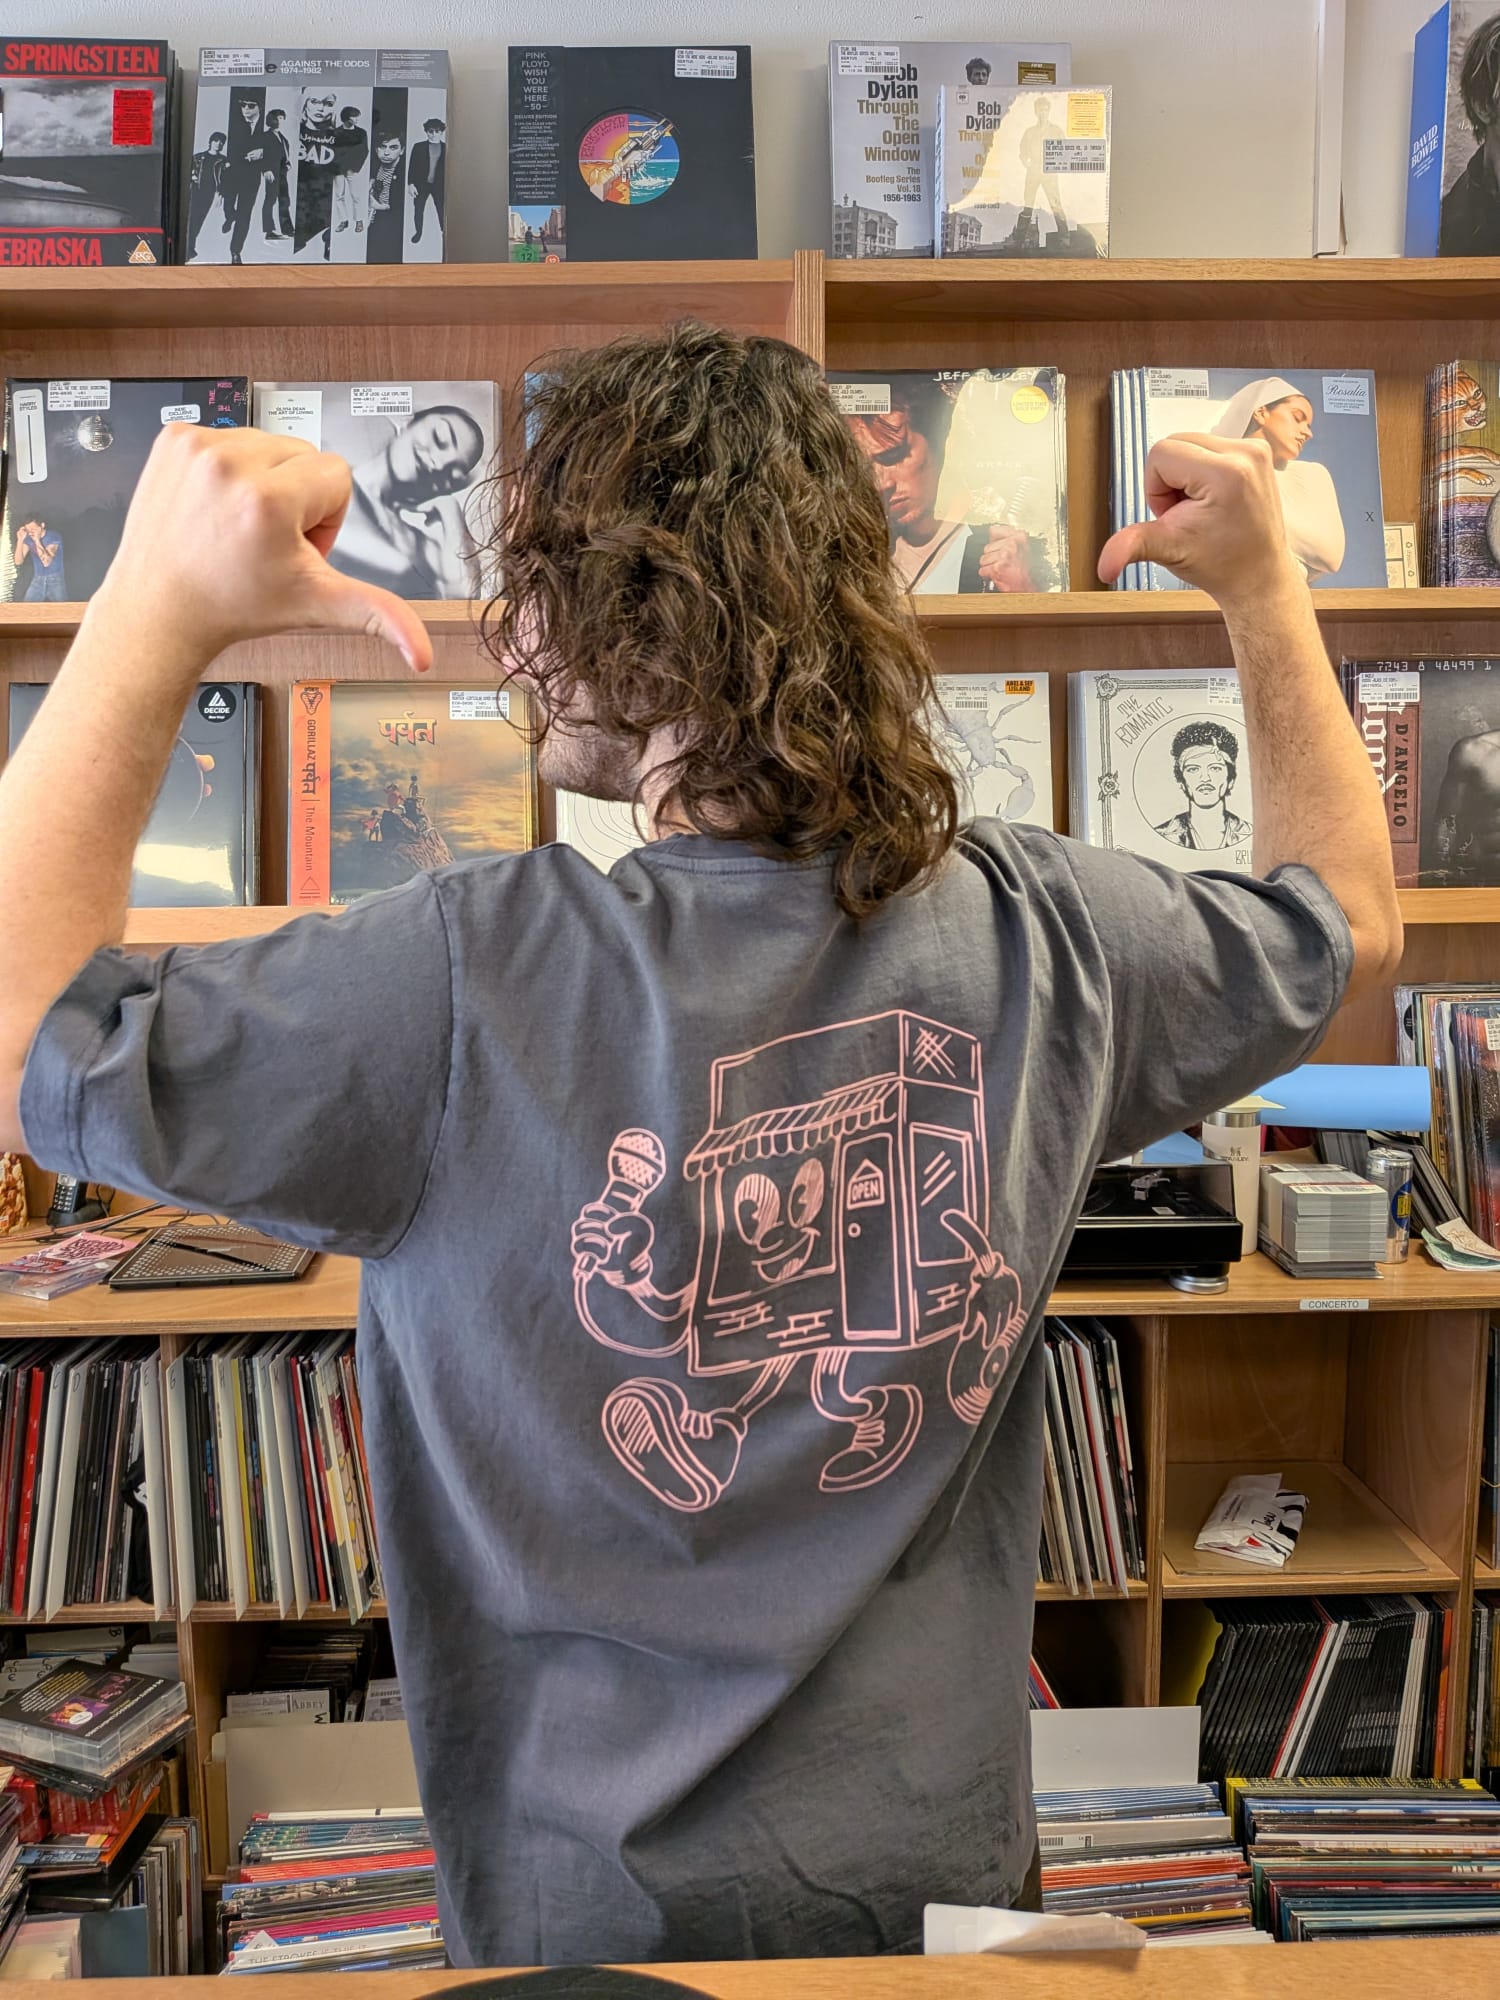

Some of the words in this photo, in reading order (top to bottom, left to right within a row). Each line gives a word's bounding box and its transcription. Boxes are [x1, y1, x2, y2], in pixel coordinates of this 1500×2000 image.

[4, 42, 160, 74] SPRINGSTEEN
[525, 52, 547, 60] PINK
[280, 60, 322, 68] AGAINST
[325, 60, 343, 68] THE
[344, 60, 370, 68] ODDS
[521, 60, 550, 68] FLOYD
[523, 68, 548, 76] WISH
[526, 77, 546, 85] YOU
[524, 94, 548, 102] HERE
[868, 81, 919, 101] Dylan
[857, 99, 919, 117] Through
[977, 101, 1001, 116] Bob
[893, 115, 920, 131] The
[966, 115, 1001, 132] Dylan
[882, 130, 920, 147] Open
[1413, 124, 1438, 155] DAVID
[297, 143, 335, 165] BAD
[864, 147, 921, 162] Window
[1411, 135, 1439, 169] BOWIE
[907, 167, 921, 175] The
[866, 175, 895, 185] Bootleg
[896, 175, 921, 184] Series
[896, 184, 912, 193] Vol.
[912, 184, 921, 193] 18
[522, 252, 533, 261] 12
[933, 371, 971, 382] JEFF
[1365, 511, 1375, 522] X
[1377, 661, 1408, 672] 7243
[1418, 661, 1425, 671] 8
[1435, 661, 1475, 671] 48499
[1483, 661, 1492, 671] 1
[1116, 694, 1143, 719] THE
[1114, 696, 1174, 749] ROMANTIC
[306, 719, 317, 762] GORILLAZ
[1393, 723, 1409, 828] D'ANGELO
[304, 806, 316, 825] The
[304, 825, 315, 872] Mountain
[852, 1179, 879, 1202] OPEN
[1308, 1300, 1360, 1309] CONCERTO
[292, 1699, 324, 1711] ABBEY
